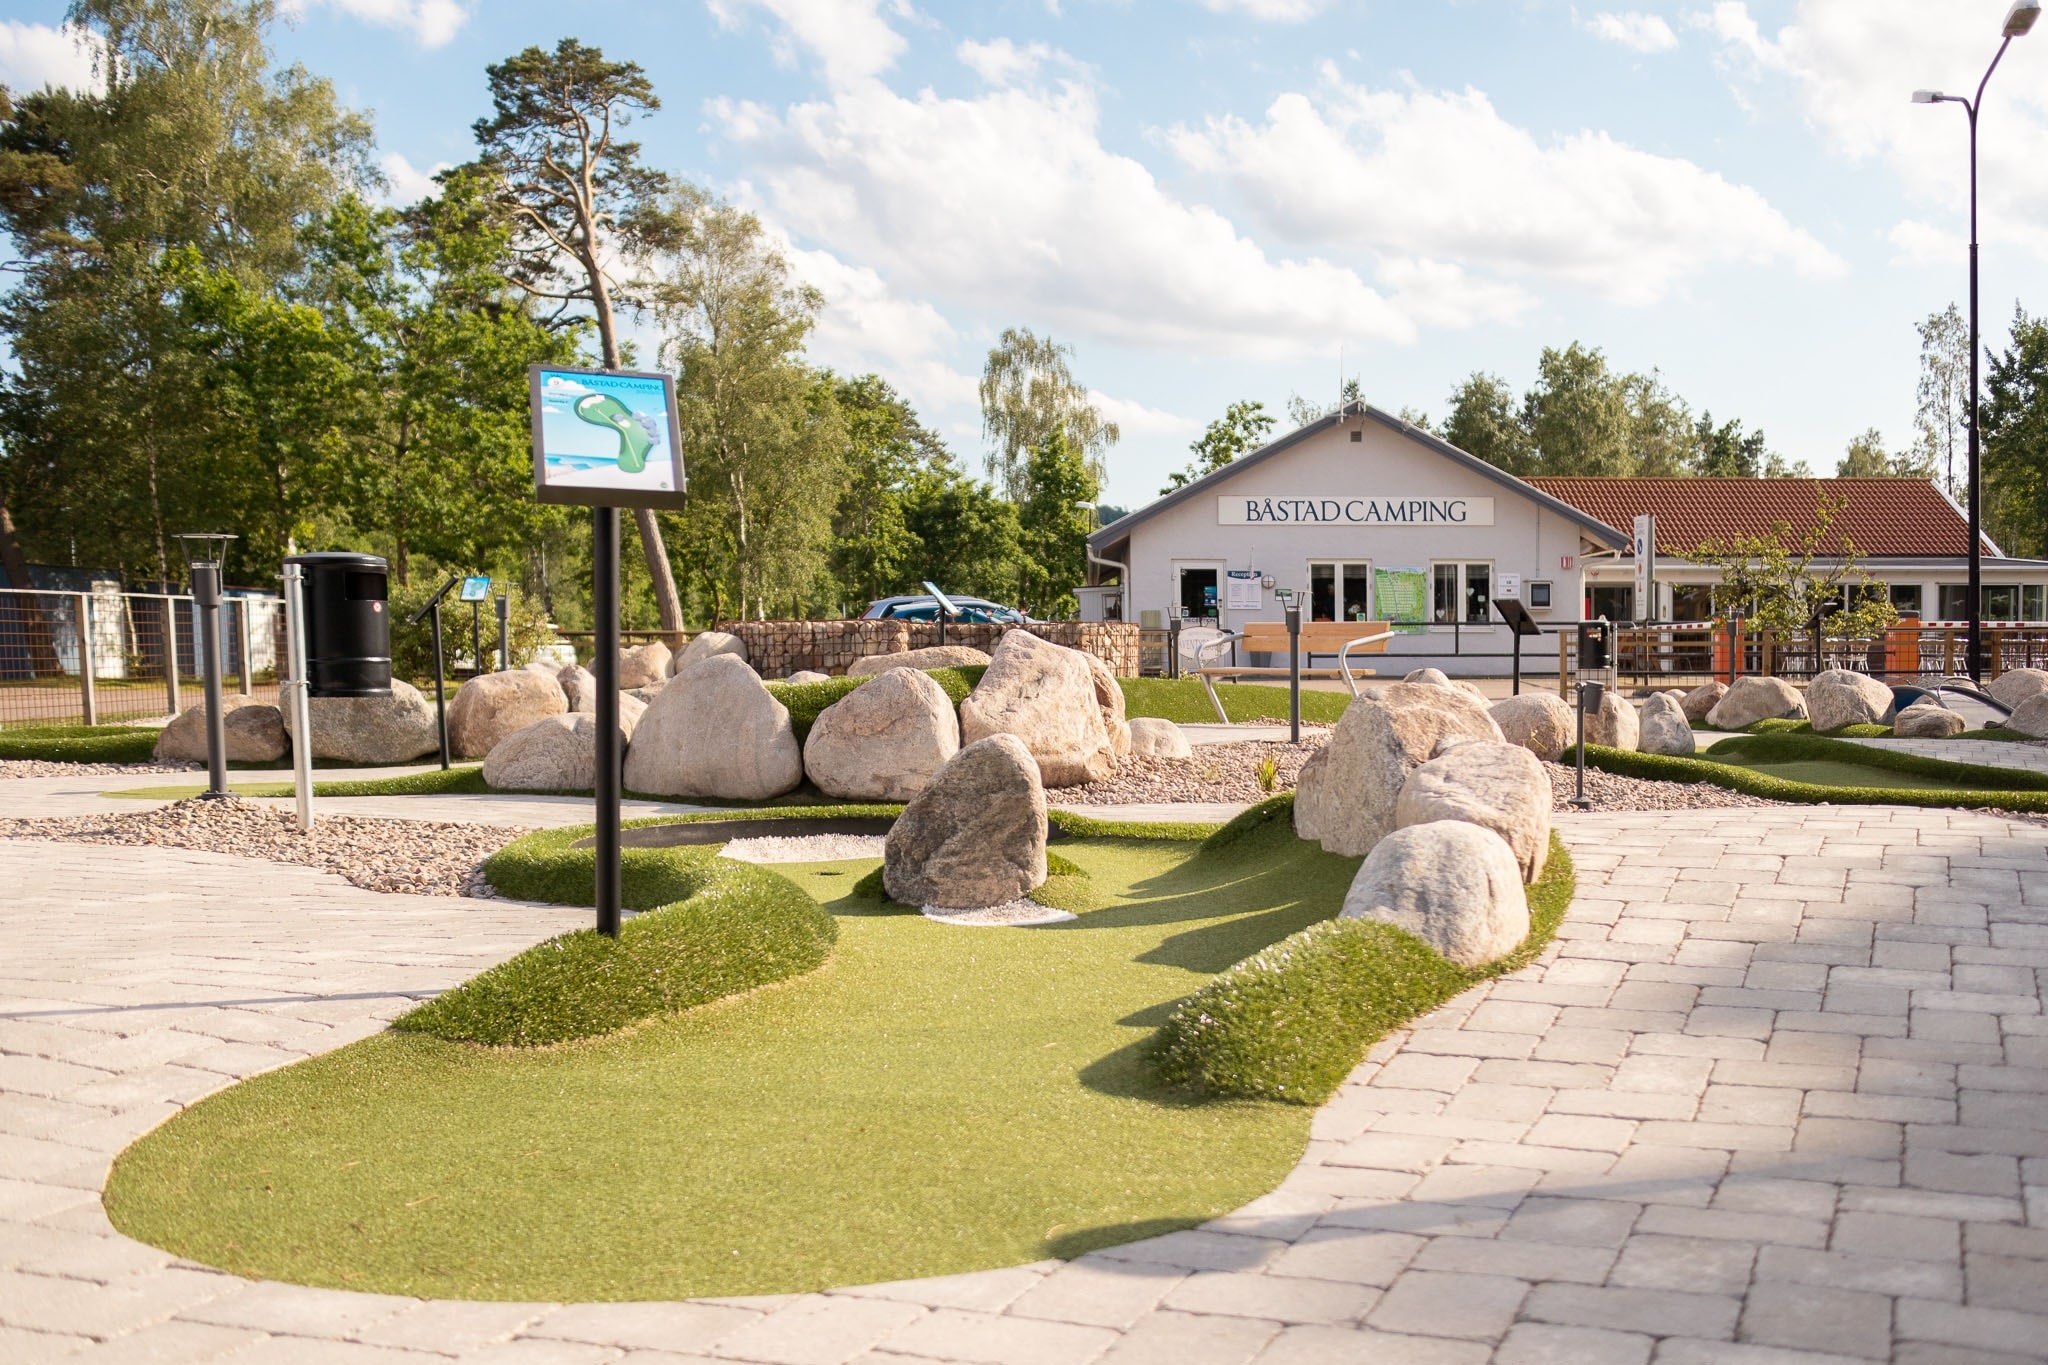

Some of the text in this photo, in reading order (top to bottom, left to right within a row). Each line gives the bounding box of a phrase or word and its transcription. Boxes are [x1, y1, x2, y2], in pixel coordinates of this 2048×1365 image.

[1246, 498, 1467, 522] BÅSTAD CAMPING
[1231, 571, 1258, 579] Receptin
